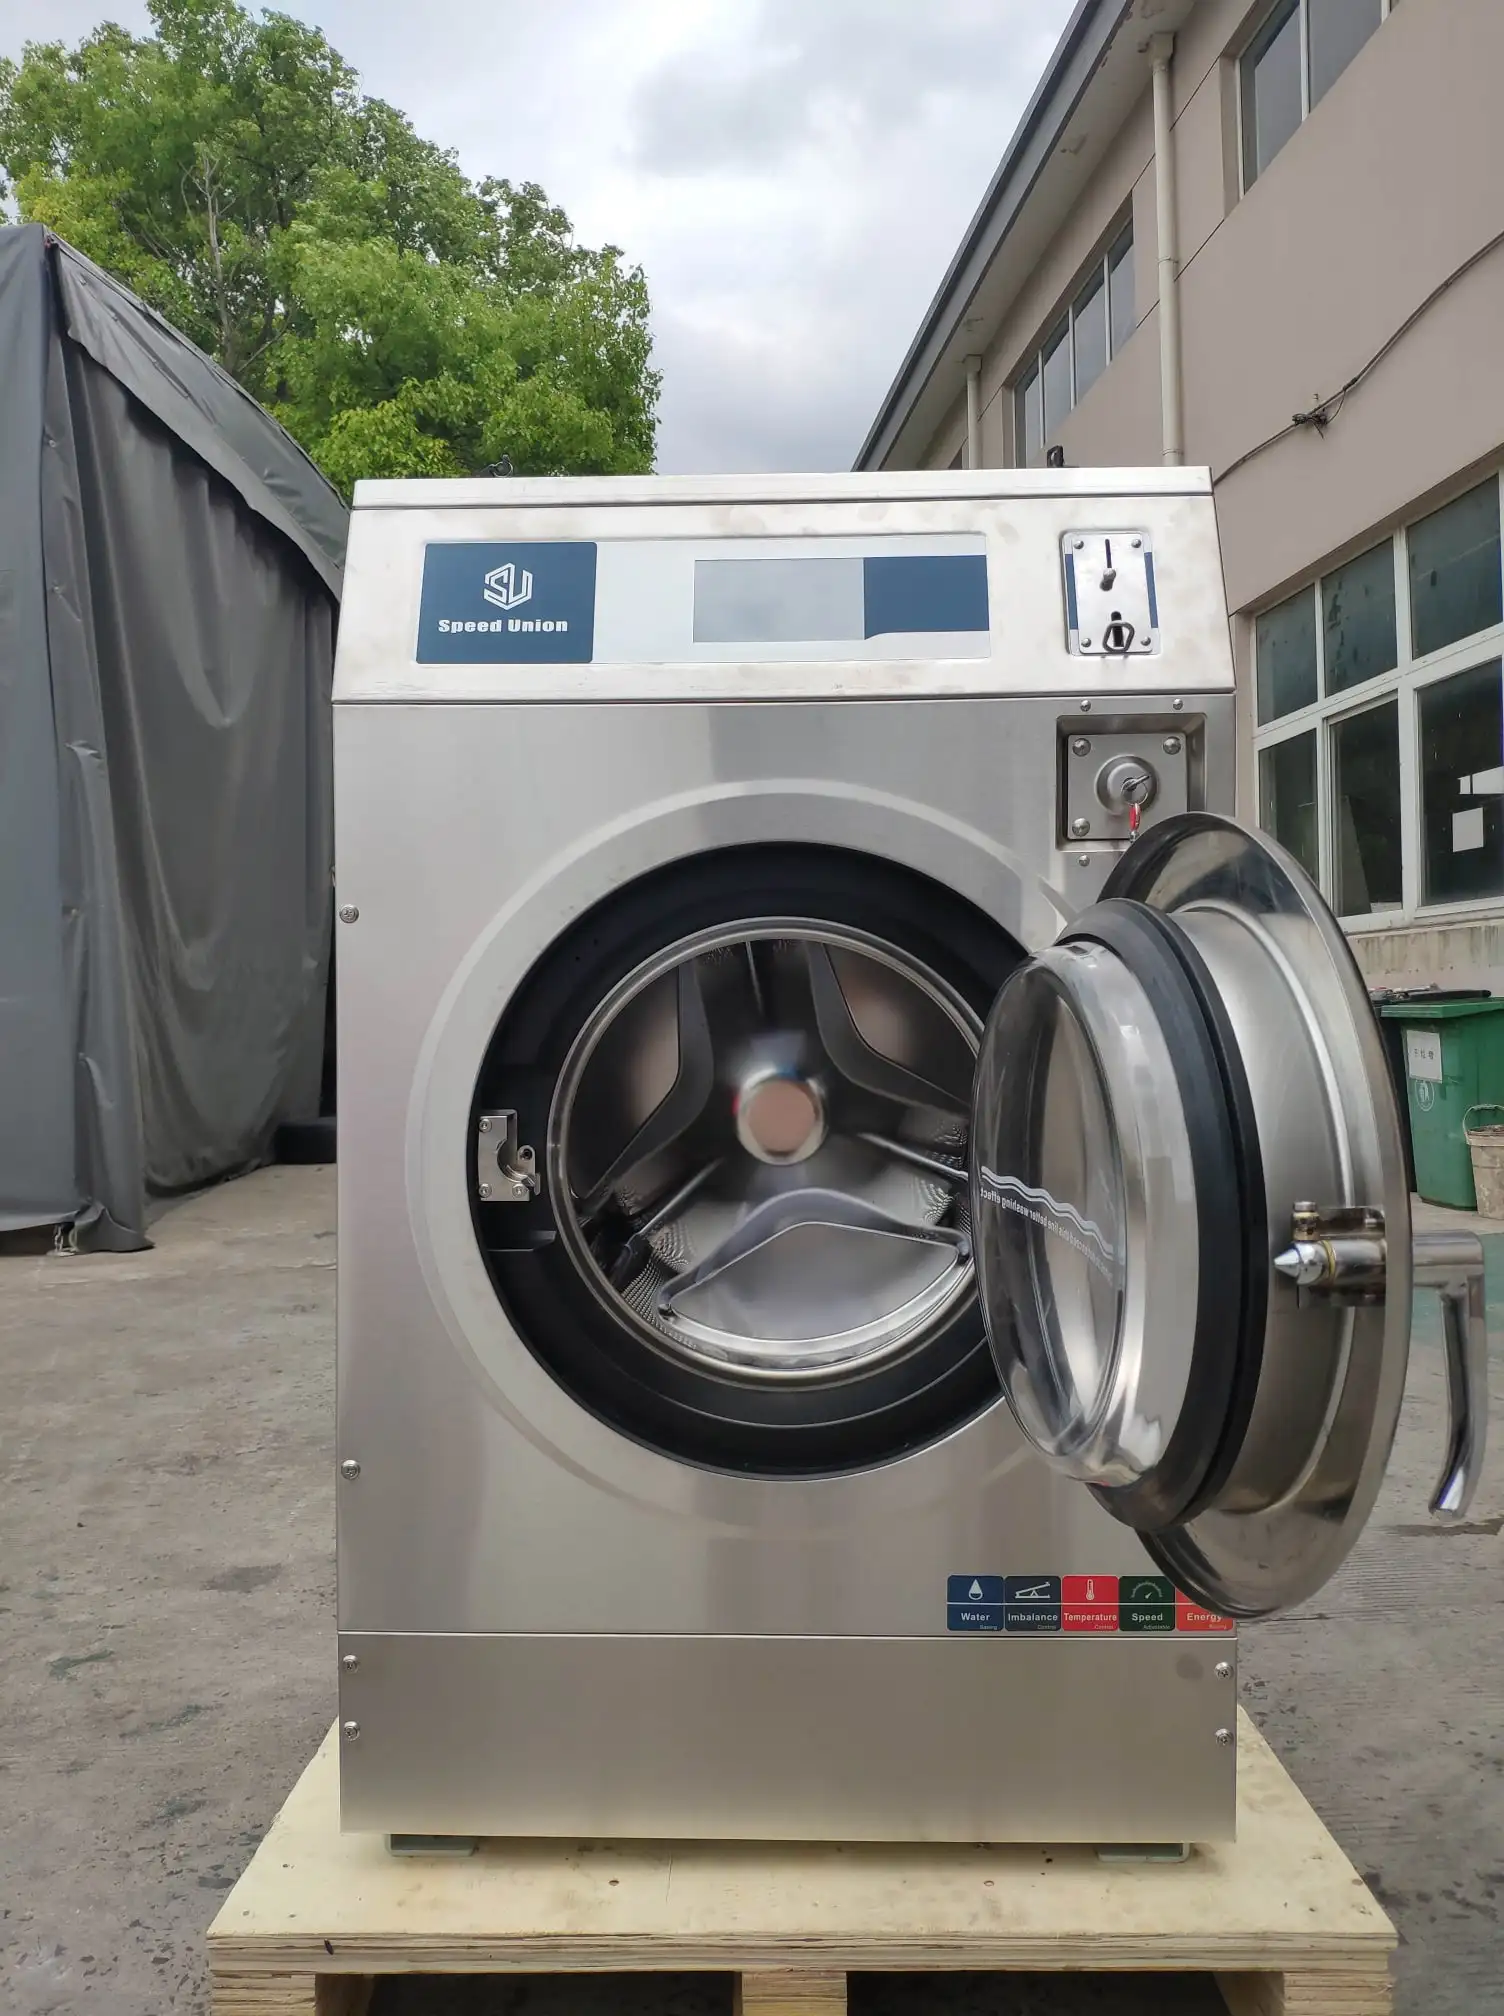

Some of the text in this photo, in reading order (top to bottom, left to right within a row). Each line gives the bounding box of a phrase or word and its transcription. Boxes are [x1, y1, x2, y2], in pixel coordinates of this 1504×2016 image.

[438, 619, 568, 634] Speed Union
[961, 1612, 991, 1621] Water
[1008, 1613, 1058, 1621] Imbalance
[1064, 1612, 1117, 1622] Temperature
[1131, 1613, 1163, 1622] Speed
[1187, 1612, 1222, 1622] Energy
